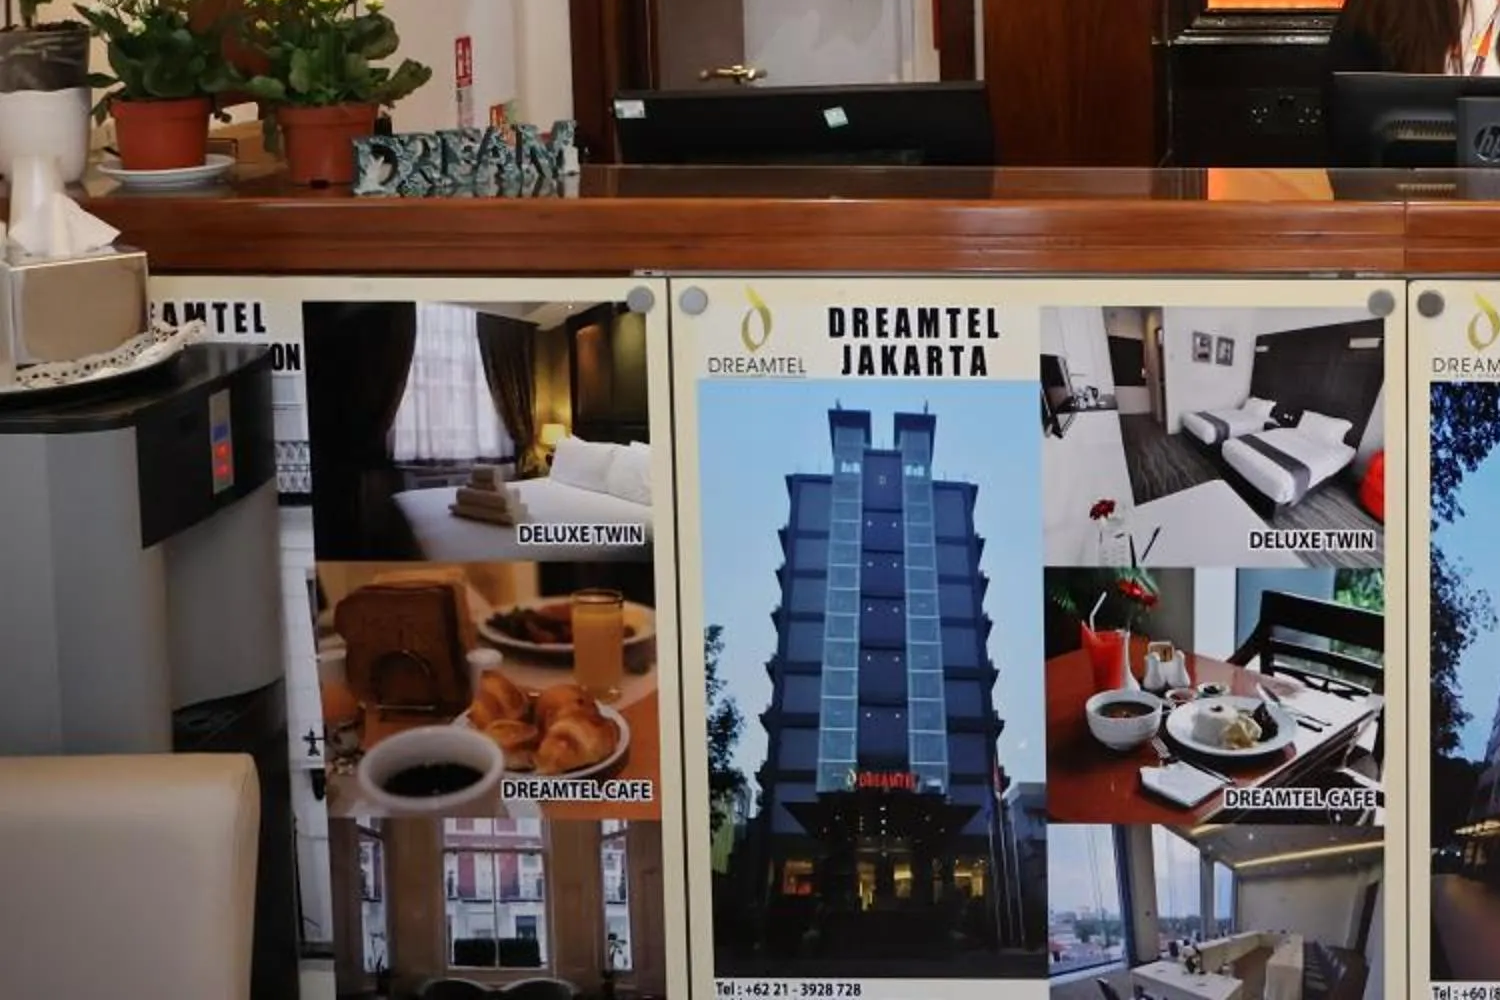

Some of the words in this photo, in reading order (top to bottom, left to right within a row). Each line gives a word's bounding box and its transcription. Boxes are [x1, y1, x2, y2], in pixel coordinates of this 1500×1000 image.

[149, 302, 266, 335] AMTEL
[828, 307, 999, 339] DREAMTEL
[708, 356, 806, 374] DREAMTEL
[841, 344, 987, 377] JAKARTA
[519, 525, 591, 543] DELUXE
[593, 525, 642, 543] TWIN
[1250, 531, 1321, 549] DELUXE
[1323, 531, 1374, 549] TWIN
[503, 781, 601, 799] DREAMTEL
[605, 781, 651, 799] CAFE
[1225, 790, 1324, 807] DREAMTEL
[1327, 790, 1375, 807] CAFE
[715, 981, 735, 996] Tel
[745, 982, 770, 997] +62
[773, 982, 788, 996] 21
[801, 983, 834, 997] 3928
[837, 983, 862, 997] 728
[1432, 986, 1451, 1000] Tel
[1461, 987, 1487, 1000] +60
